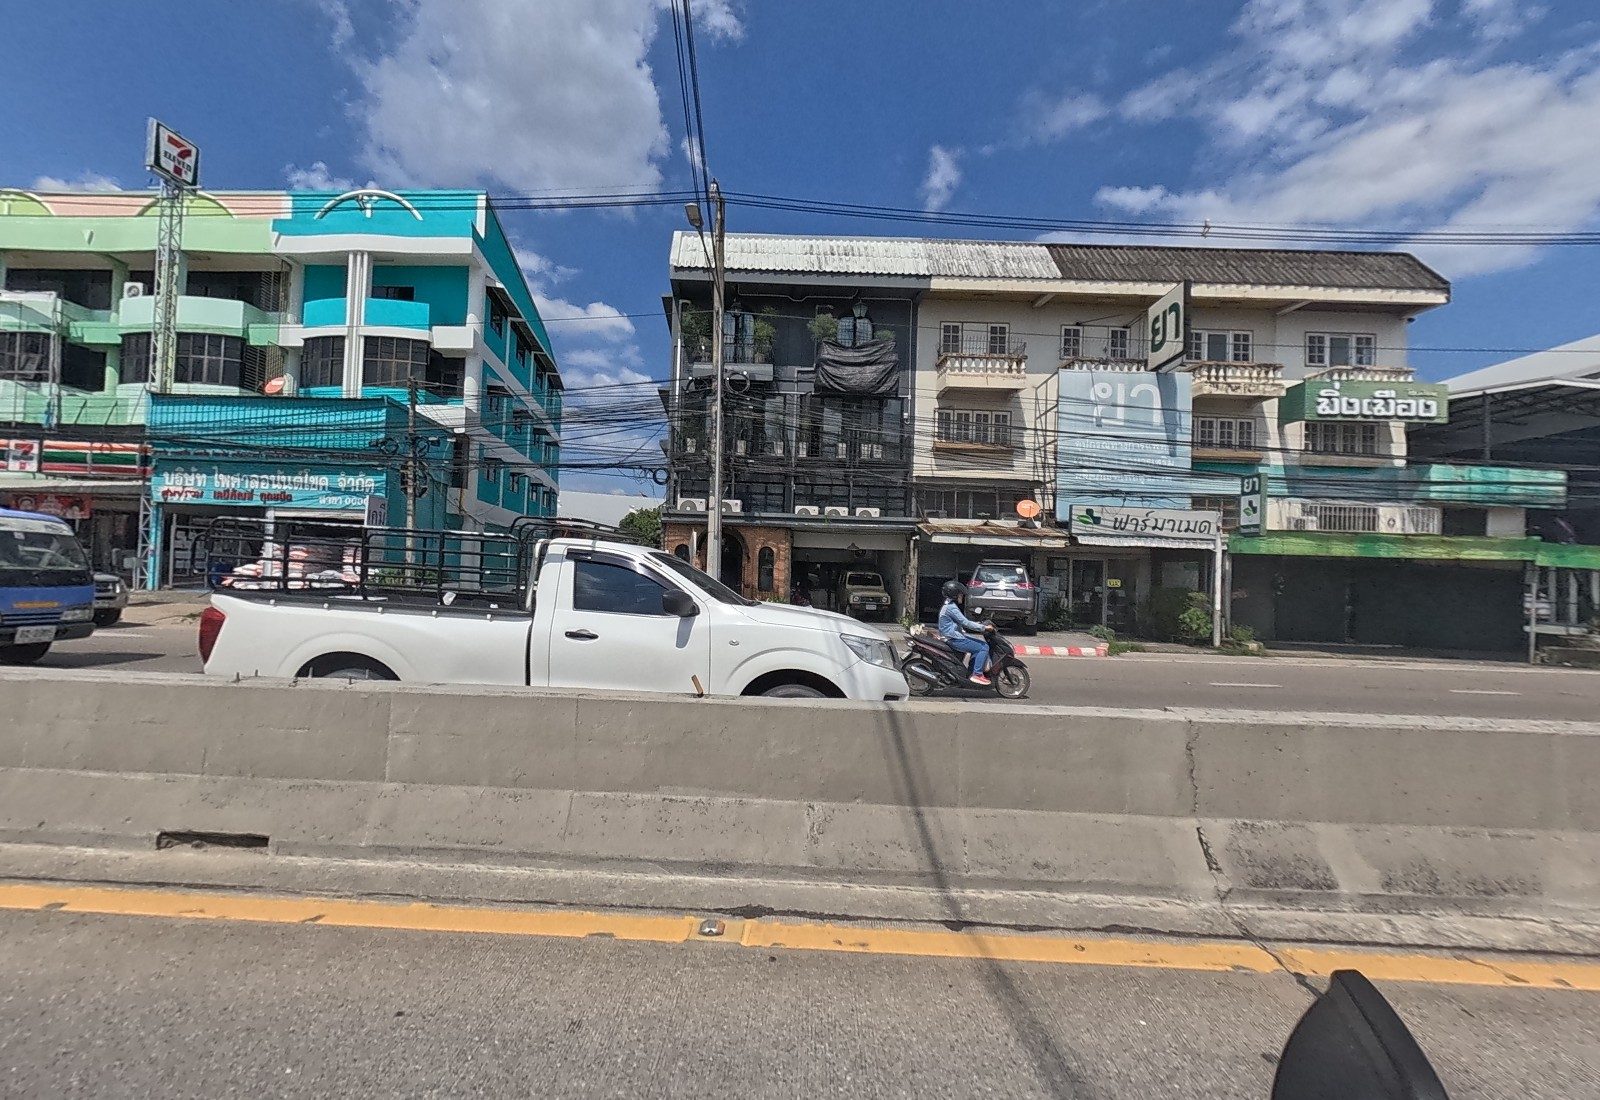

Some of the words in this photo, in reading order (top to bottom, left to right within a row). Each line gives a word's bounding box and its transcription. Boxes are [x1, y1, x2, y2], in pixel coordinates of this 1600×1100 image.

[1151, 301, 1181, 353] ยา
[1090, 382, 1164, 427] ยา
[163, 466, 207, 487] บริษัท
[337, 471, 375, 495] จำกัด
[1243, 477, 1259, 493] ยา
[1113, 510, 1212, 535] ฟาร์มาเมด
